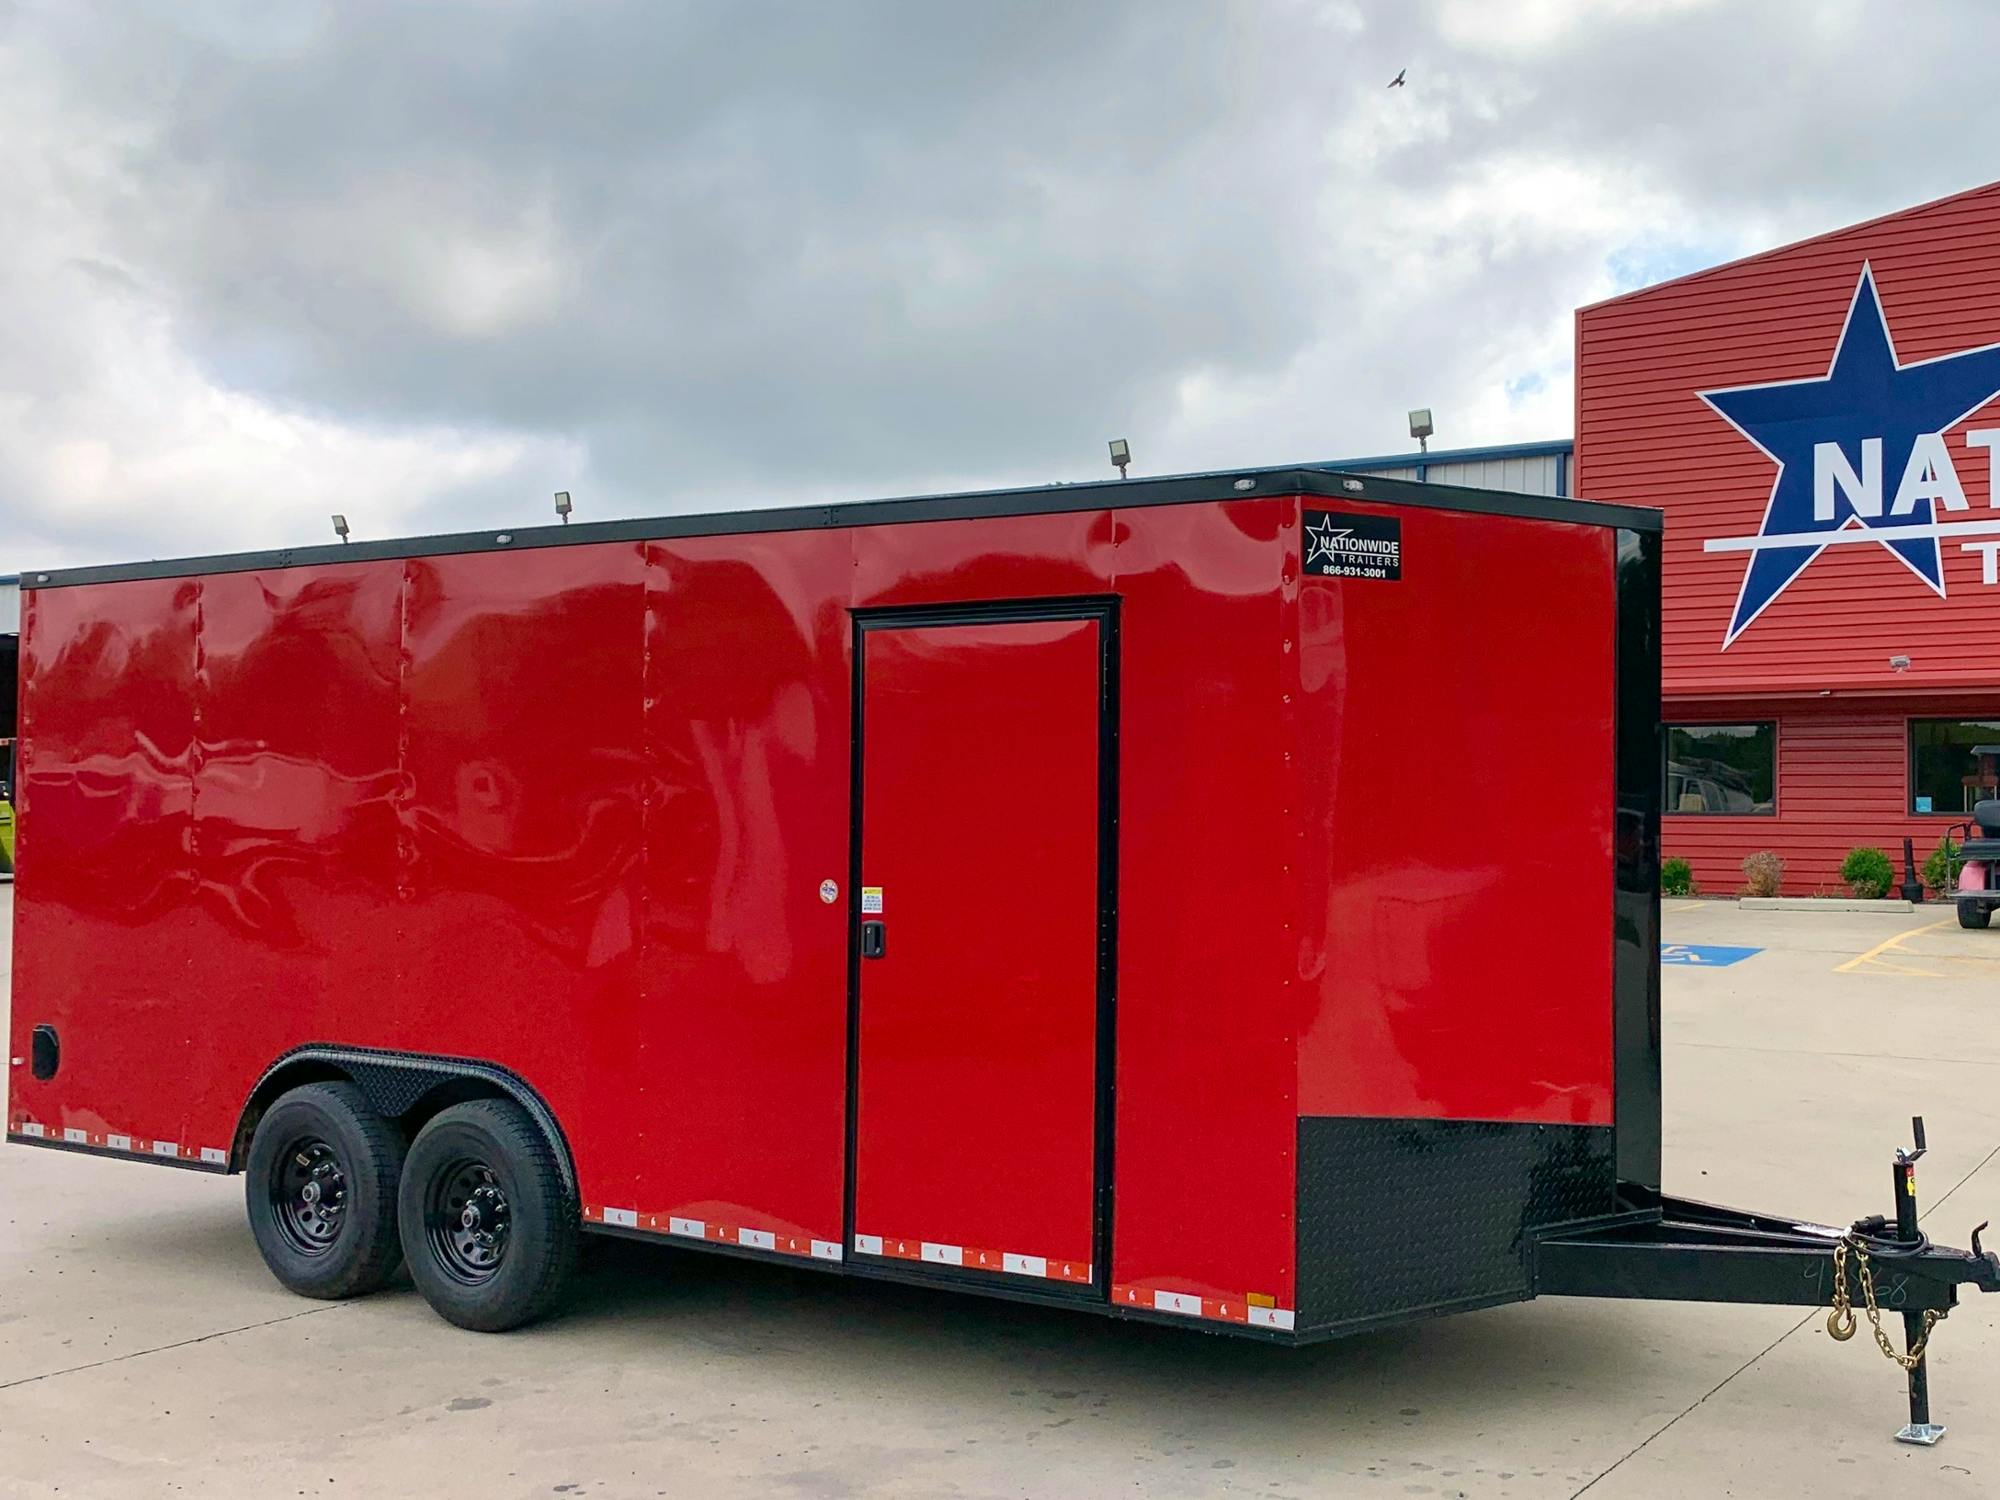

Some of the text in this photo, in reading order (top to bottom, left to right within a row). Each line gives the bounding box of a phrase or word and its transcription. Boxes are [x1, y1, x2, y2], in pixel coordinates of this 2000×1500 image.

[1320, 535, 1399, 554] NATIONWIDE
[1341, 554, 1399, 567] TRAILERS
[1322, 564, 1386, 578] 866-931-3001
